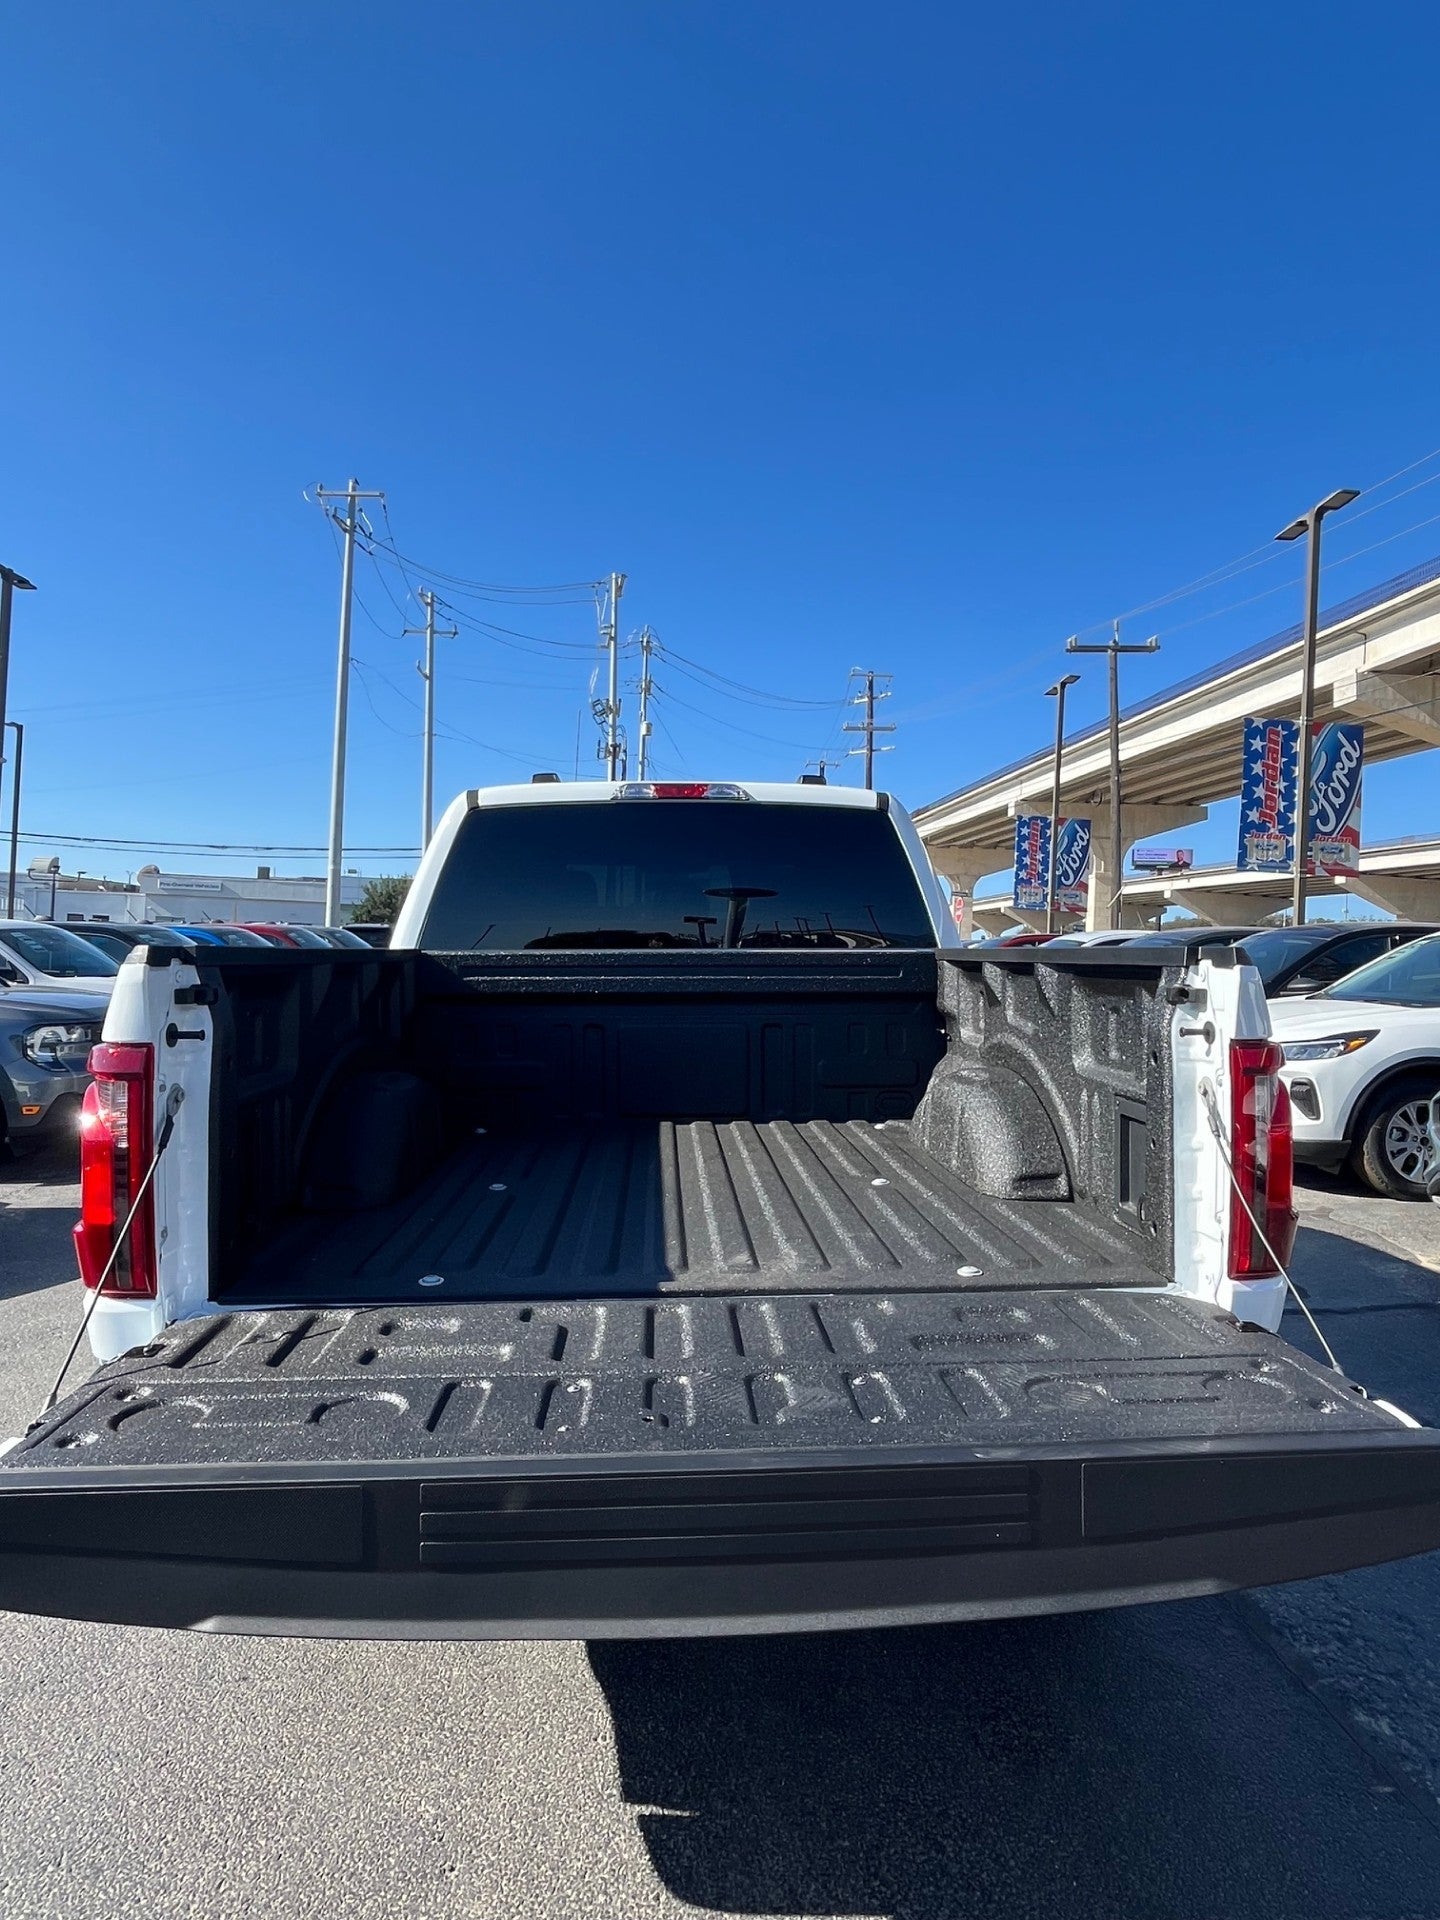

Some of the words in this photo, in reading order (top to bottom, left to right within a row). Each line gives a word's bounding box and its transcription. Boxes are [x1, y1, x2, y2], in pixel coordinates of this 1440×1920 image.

[1258, 727, 1282, 829] Jordan
[1309, 730, 1361, 833] Ford
[1027, 819, 1041, 883] Jordan
[1056, 822, 1090, 886] Ford
[1250, 830, 1287, 841] Jordan
[1314, 833, 1353, 844] Jordan
